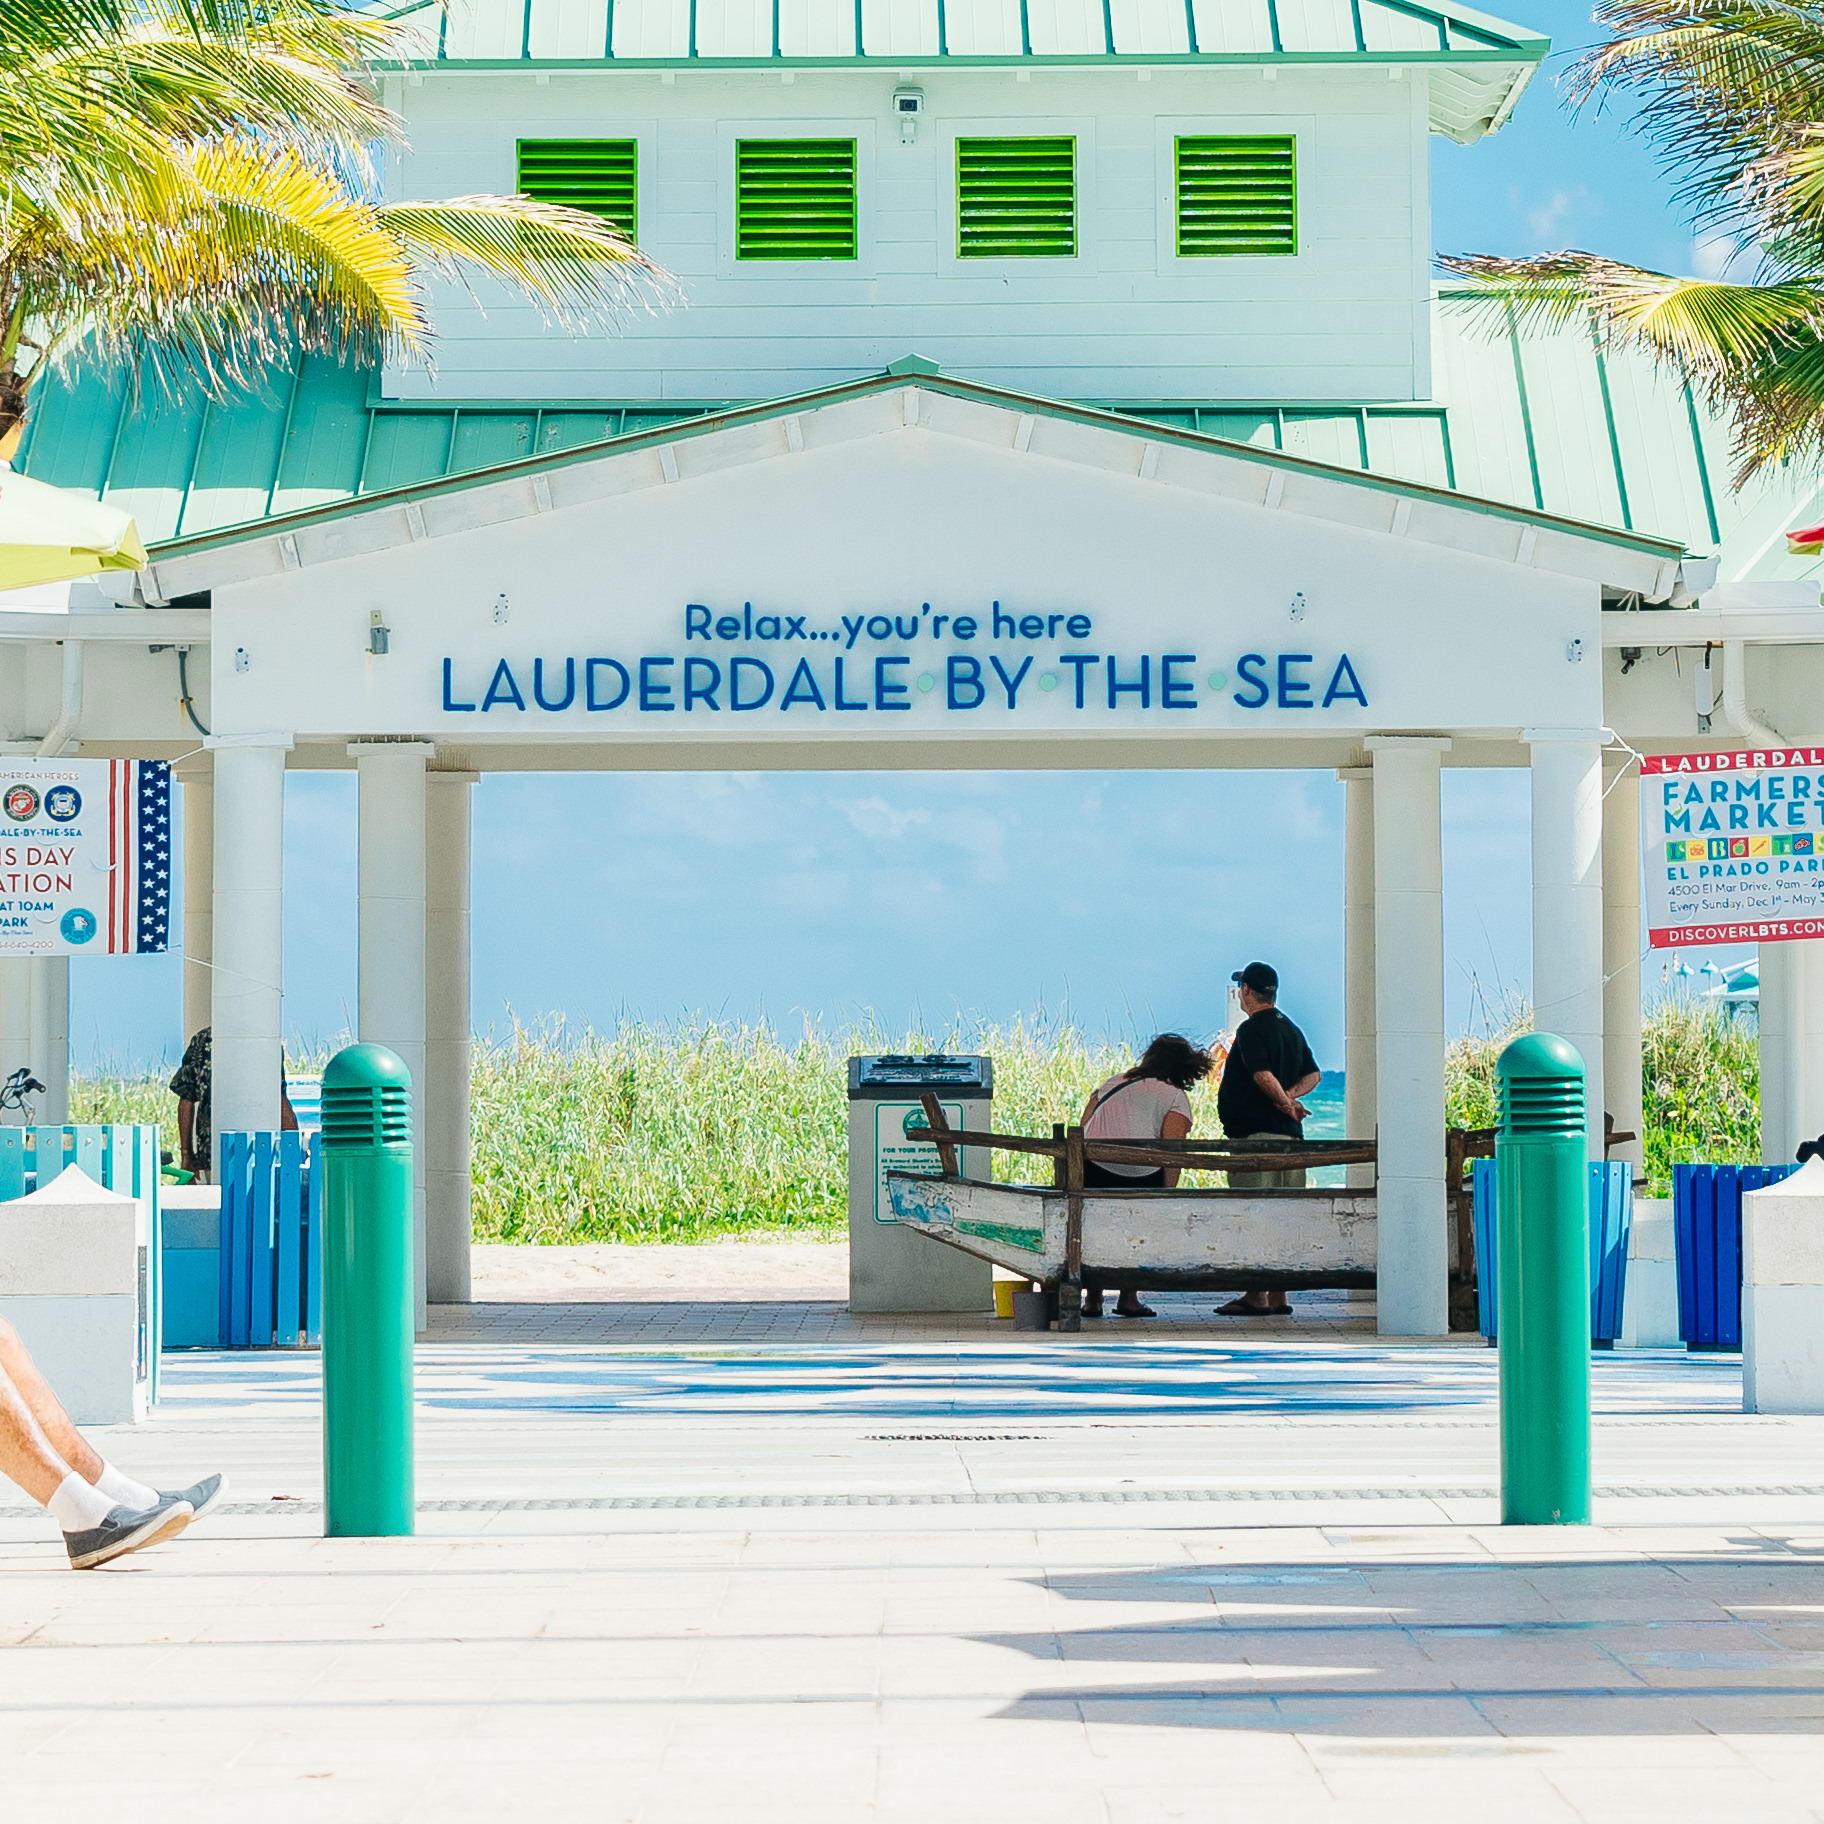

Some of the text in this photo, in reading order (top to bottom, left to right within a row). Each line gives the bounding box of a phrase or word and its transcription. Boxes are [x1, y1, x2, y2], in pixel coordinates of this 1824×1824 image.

[992, 601, 1092, 638] here
[442, 653, 1369, 712] LAUDERDALE BY THE SEA
[44, 773, 80, 781] HEROES
[27, 847, 76, 866] DAY
[1667, 867, 1689, 881] EL
[1699, 861, 1769, 878] PRADO
[1668, 884, 1701, 896] 4500
[1702, 883, 1713, 894] El
[1715, 882, 1737, 894] Mar
[1775, 878, 1801, 890] 9am
[19, 901, 55, 912] 10AM
[1669, 901, 1699, 914] Every
[1747, 896, 1769, 908] Dec
[1791, 893, 1817, 908] May
